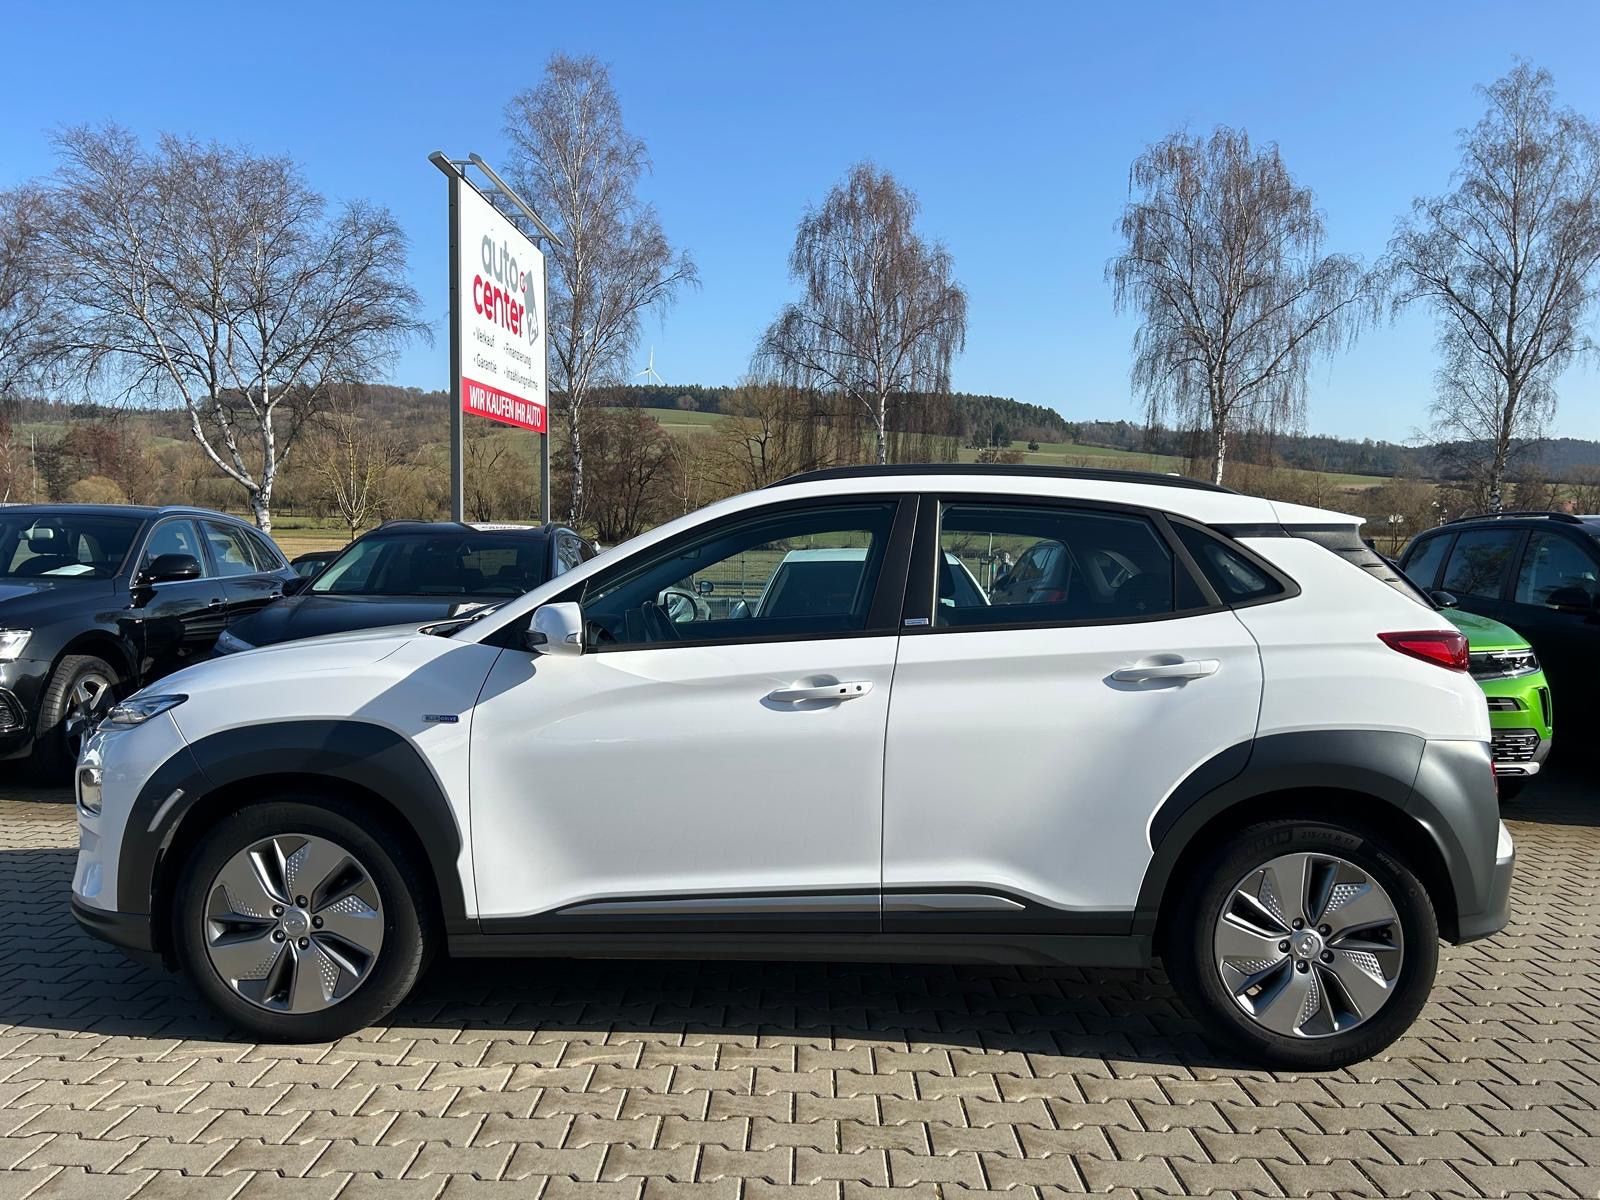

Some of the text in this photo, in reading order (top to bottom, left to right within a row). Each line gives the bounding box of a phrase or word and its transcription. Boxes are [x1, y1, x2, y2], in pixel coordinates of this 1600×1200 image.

[482, 234, 519, 294] auto
[473, 273, 525, 338] center
[469, 384, 542, 428] WIR KAUFEN IHR AUTO
